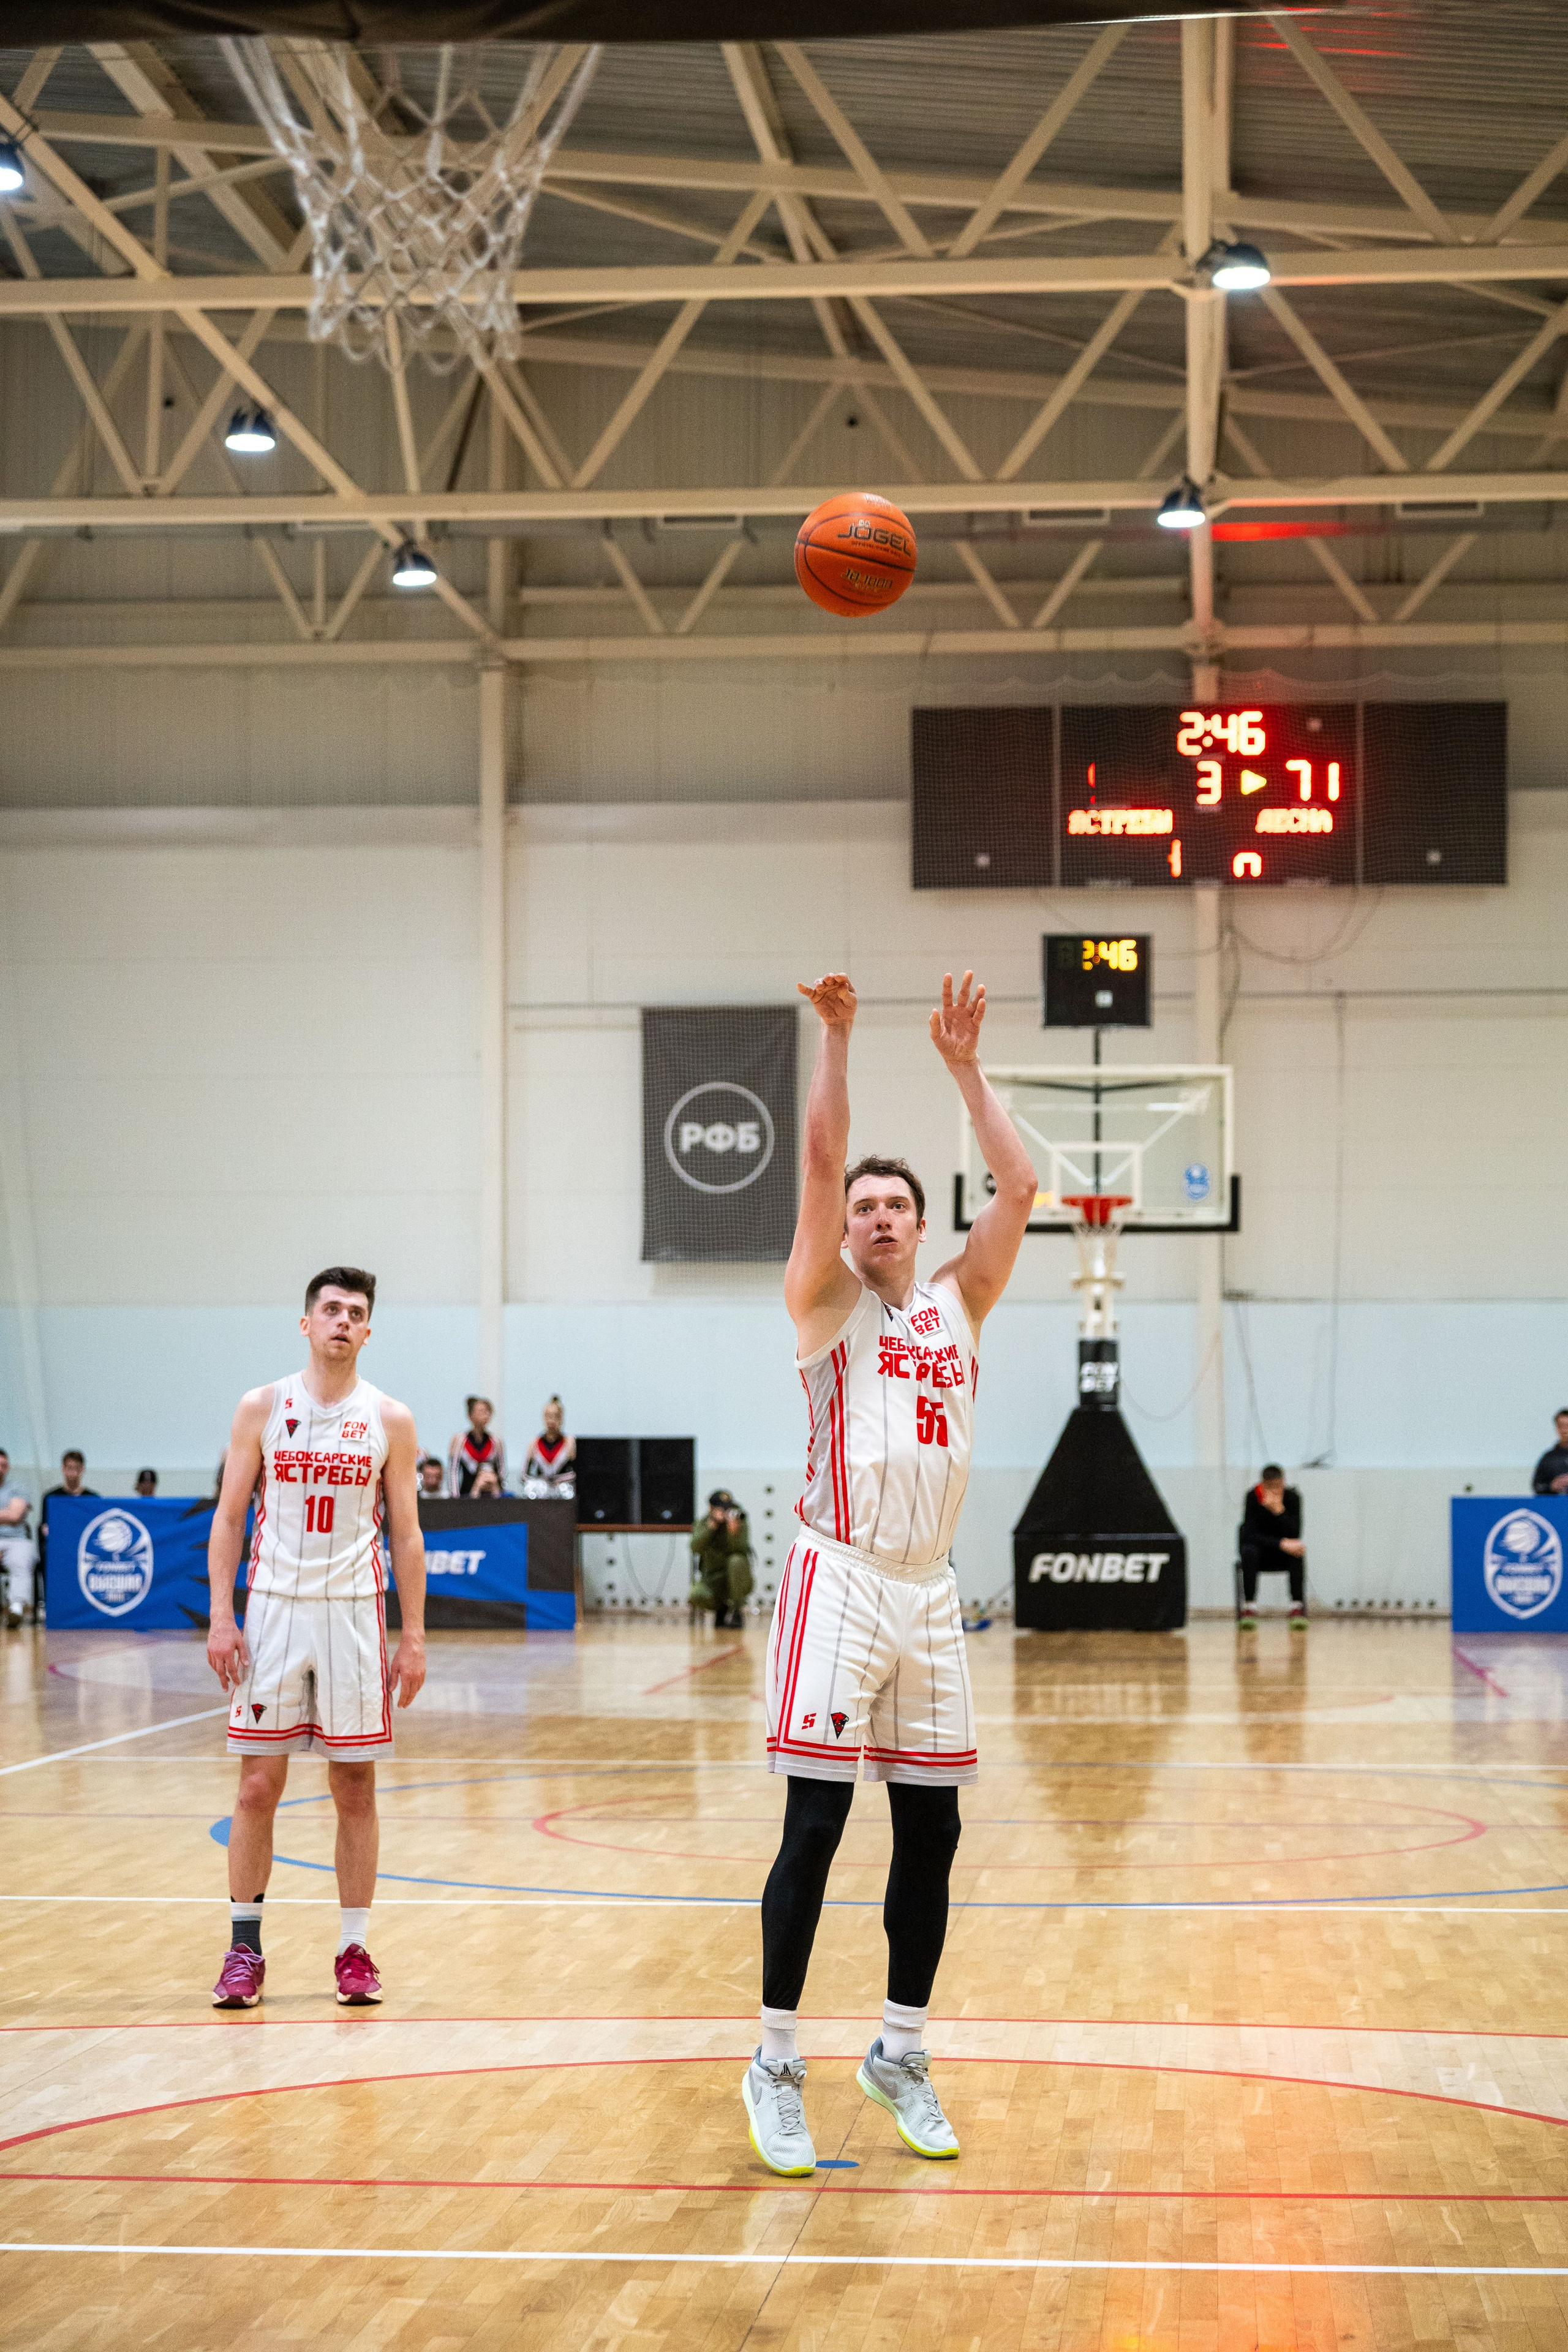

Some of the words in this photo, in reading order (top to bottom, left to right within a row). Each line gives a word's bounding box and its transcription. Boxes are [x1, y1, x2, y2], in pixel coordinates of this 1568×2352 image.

[1177, 710, 1266, 756] 2:46
[1196, 760, 1222, 805] 3
[1285, 760, 1340, 802] 71
[680, 1121, 761, 1153] РФБ
[910, 1306, 938, 1327] FON
[914, 1317, 940, 1335] BET
[877, 1351, 965, 1389] ЯСРЕБЫ
[342, 1430, 366, 1439] BET
[344, 1421, 368, 1431] FON
[916, 1395, 949, 1447] 55
[274, 1450, 372, 1468] ЧЕБОКСАРСКИЕ
[274, 1463, 372, 1487] ЯСТРЕБЫ
[305, 1495, 334, 1533] 10
[385, 1550, 487, 1575] BET
[1028, 1552, 1170, 1583] FONBET
